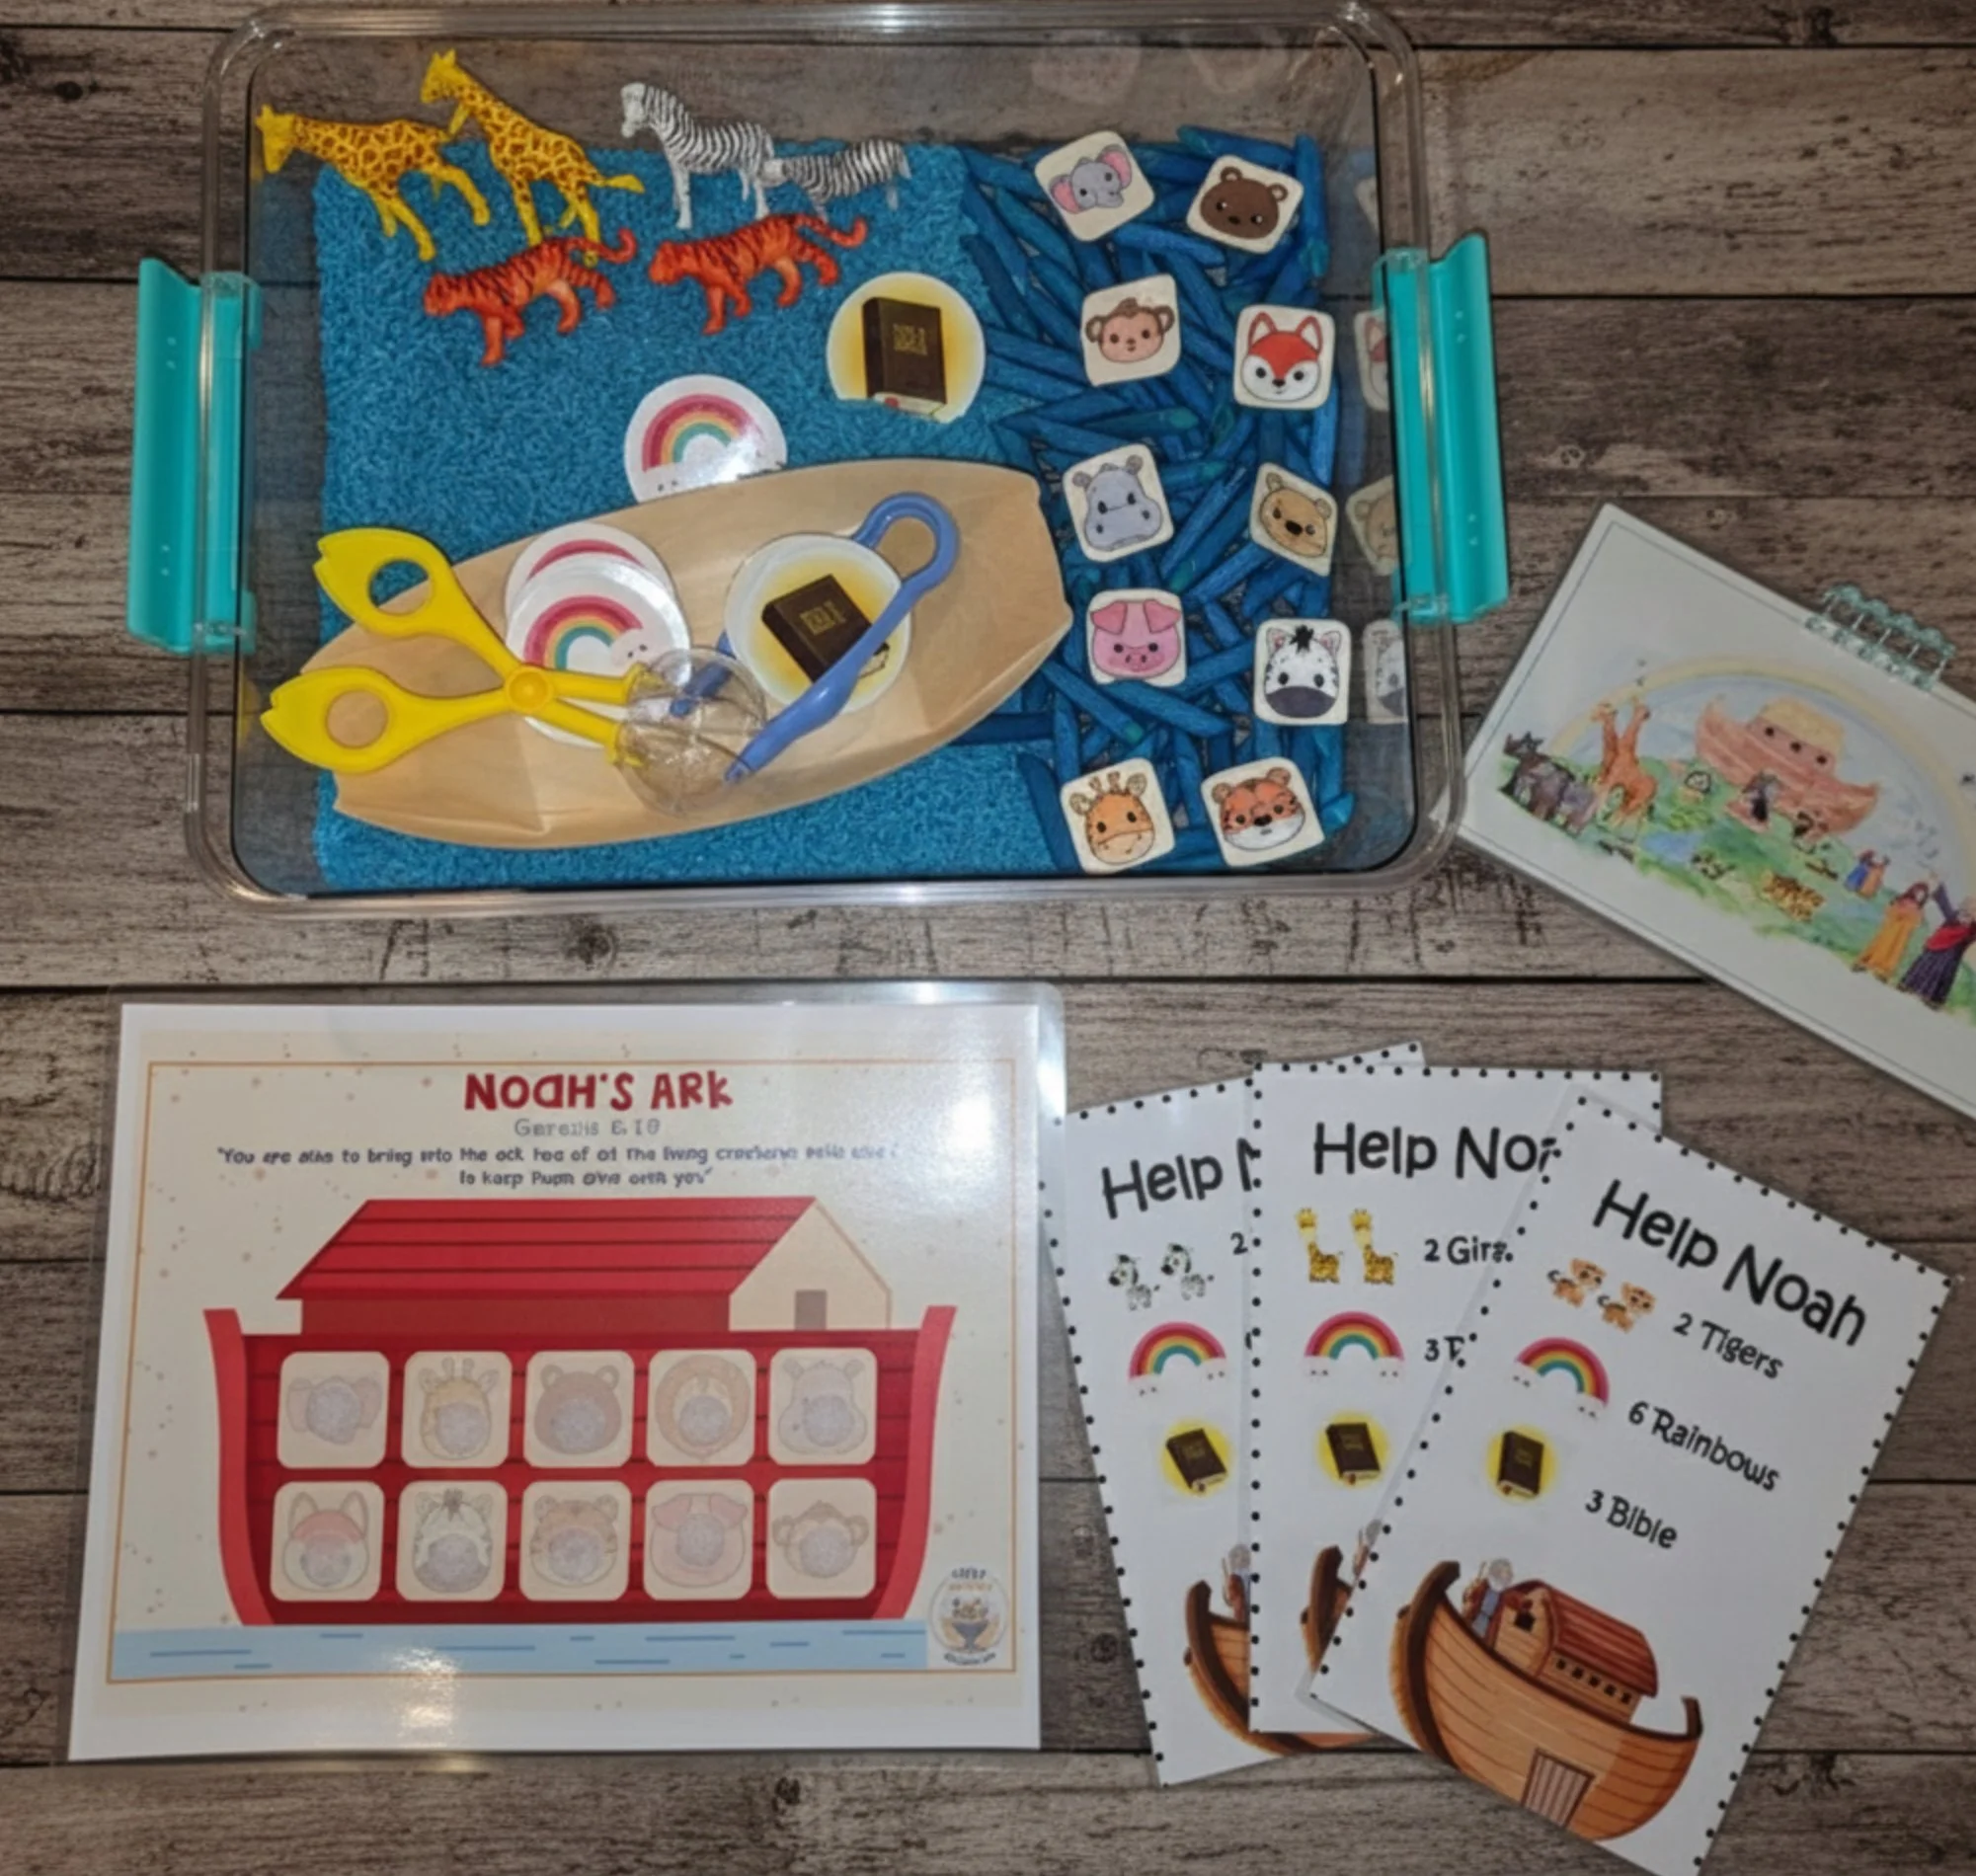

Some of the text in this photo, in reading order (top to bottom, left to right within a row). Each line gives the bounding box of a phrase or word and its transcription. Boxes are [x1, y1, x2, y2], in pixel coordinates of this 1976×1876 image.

[342, 1147, 359, 1163] to
[1314, 1122, 1438, 1179] Help
[1102, 1154, 1223, 1220] Help
[1230, 1231, 1248, 1255] 2
[1424, 1239, 1441, 1263] 2
[1592, 1179, 1866, 1347] Help Noah
[1424, 1339, 1440, 1363] 3
[1673, 1312, 1783, 1379] 2 Tigers
[1628, 1401, 1779, 1492] 6 Rainbows
[1585, 1490, 1678, 1549] 3 Bible
